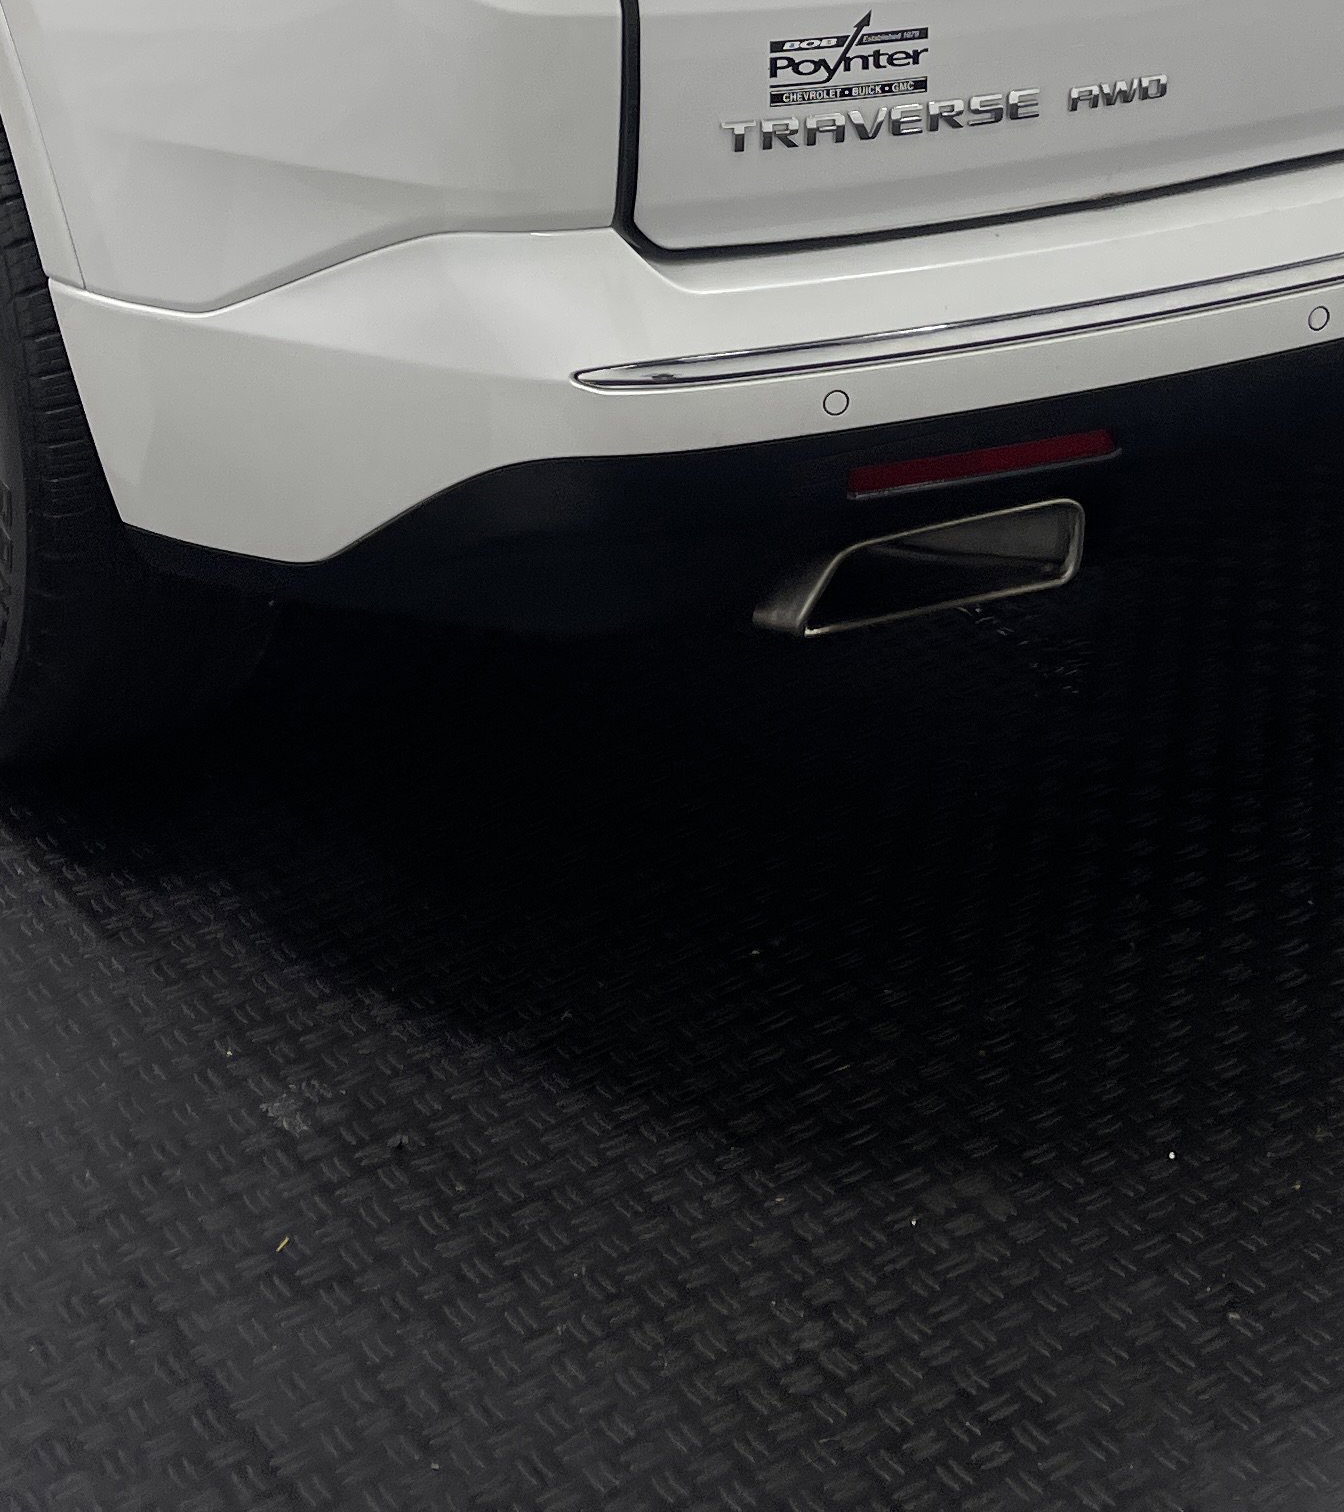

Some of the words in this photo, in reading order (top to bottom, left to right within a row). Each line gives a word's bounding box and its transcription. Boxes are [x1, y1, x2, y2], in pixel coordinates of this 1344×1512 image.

[782, 38, 838, 51] BOB
[769, 47, 929, 88] Poynter
[782, 89, 842, 103] CHEVROLET
[851, 85, 882, 96] BUICK
[892, 81, 915, 92] GMC
[720, 88, 1041, 152] TRAVERSE
[1068, 74, 1168, 112] AWD
